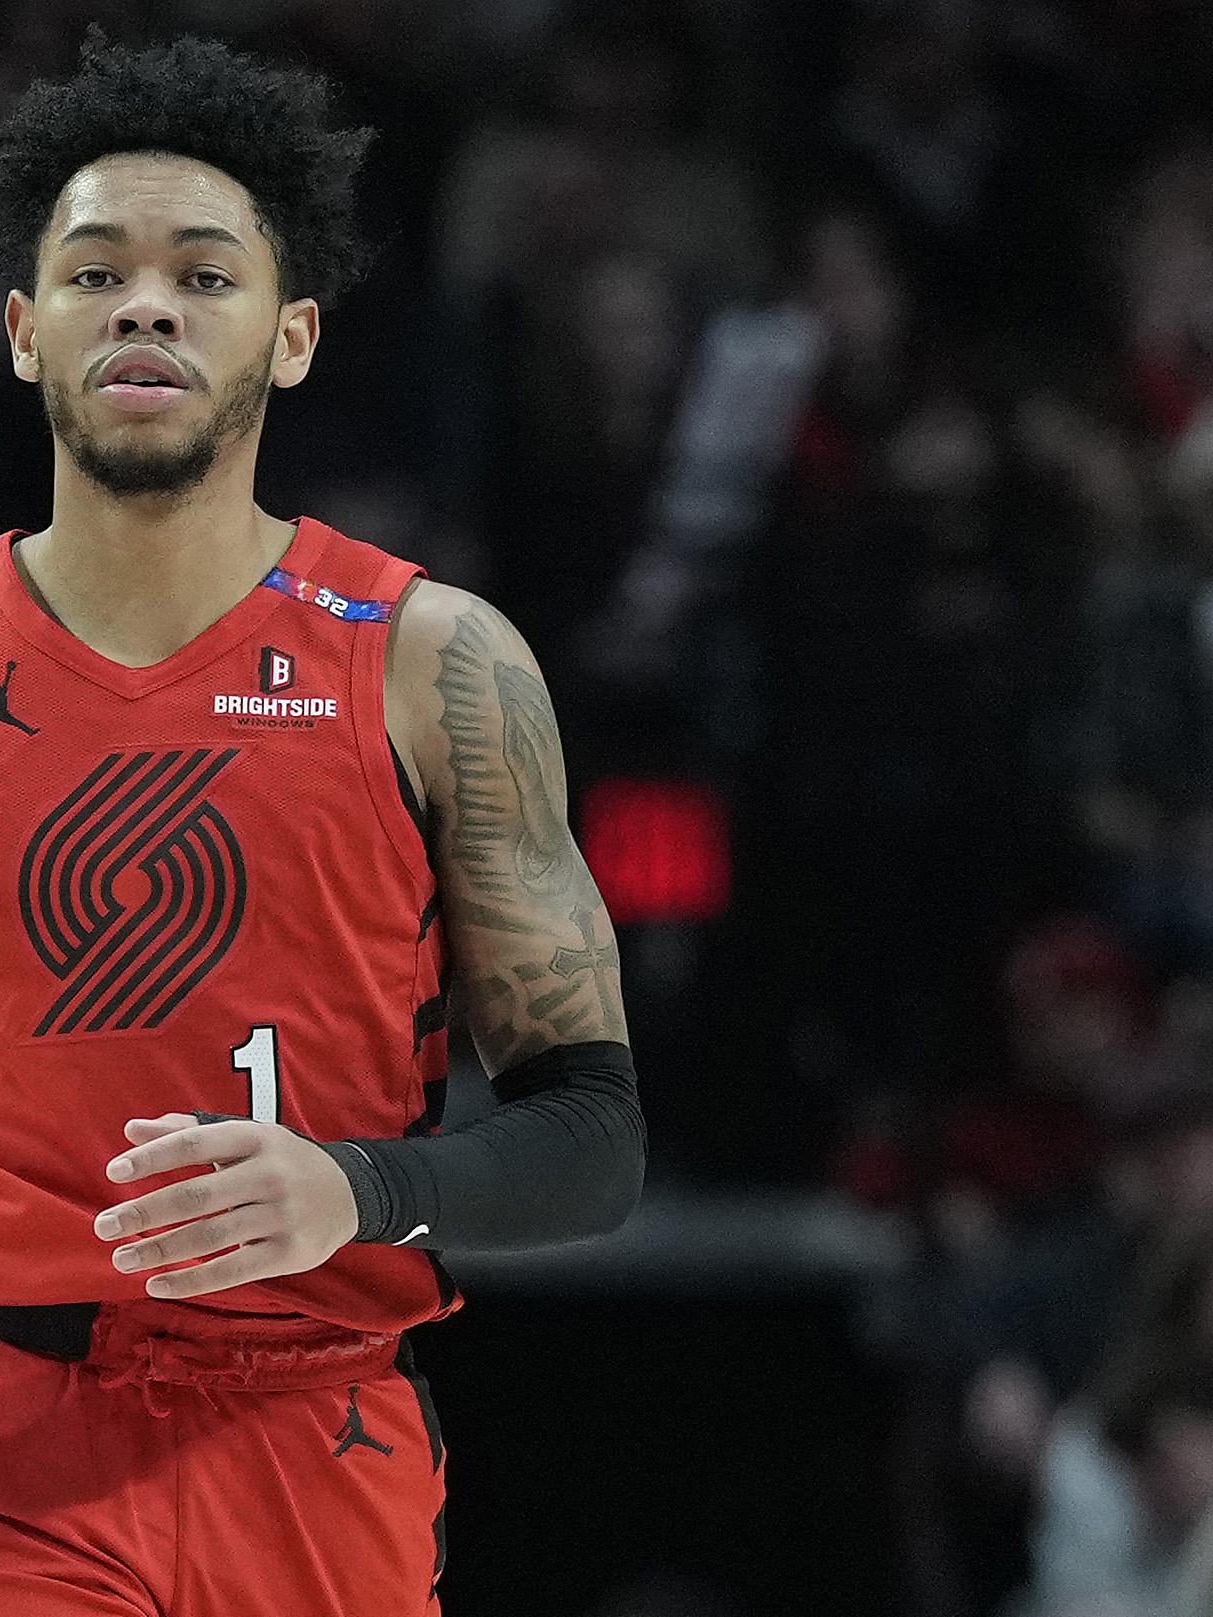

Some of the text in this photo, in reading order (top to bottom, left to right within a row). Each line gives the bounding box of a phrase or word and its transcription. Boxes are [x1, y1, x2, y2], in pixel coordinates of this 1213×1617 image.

[314, 588, 348, 617] 32
[272, 655, 289, 686] B
[214, 696, 337, 718] BRIGHTSIDE
[238, 718, 316, 729] WINDOWS
[231, 1024, 282, 1124] 1
